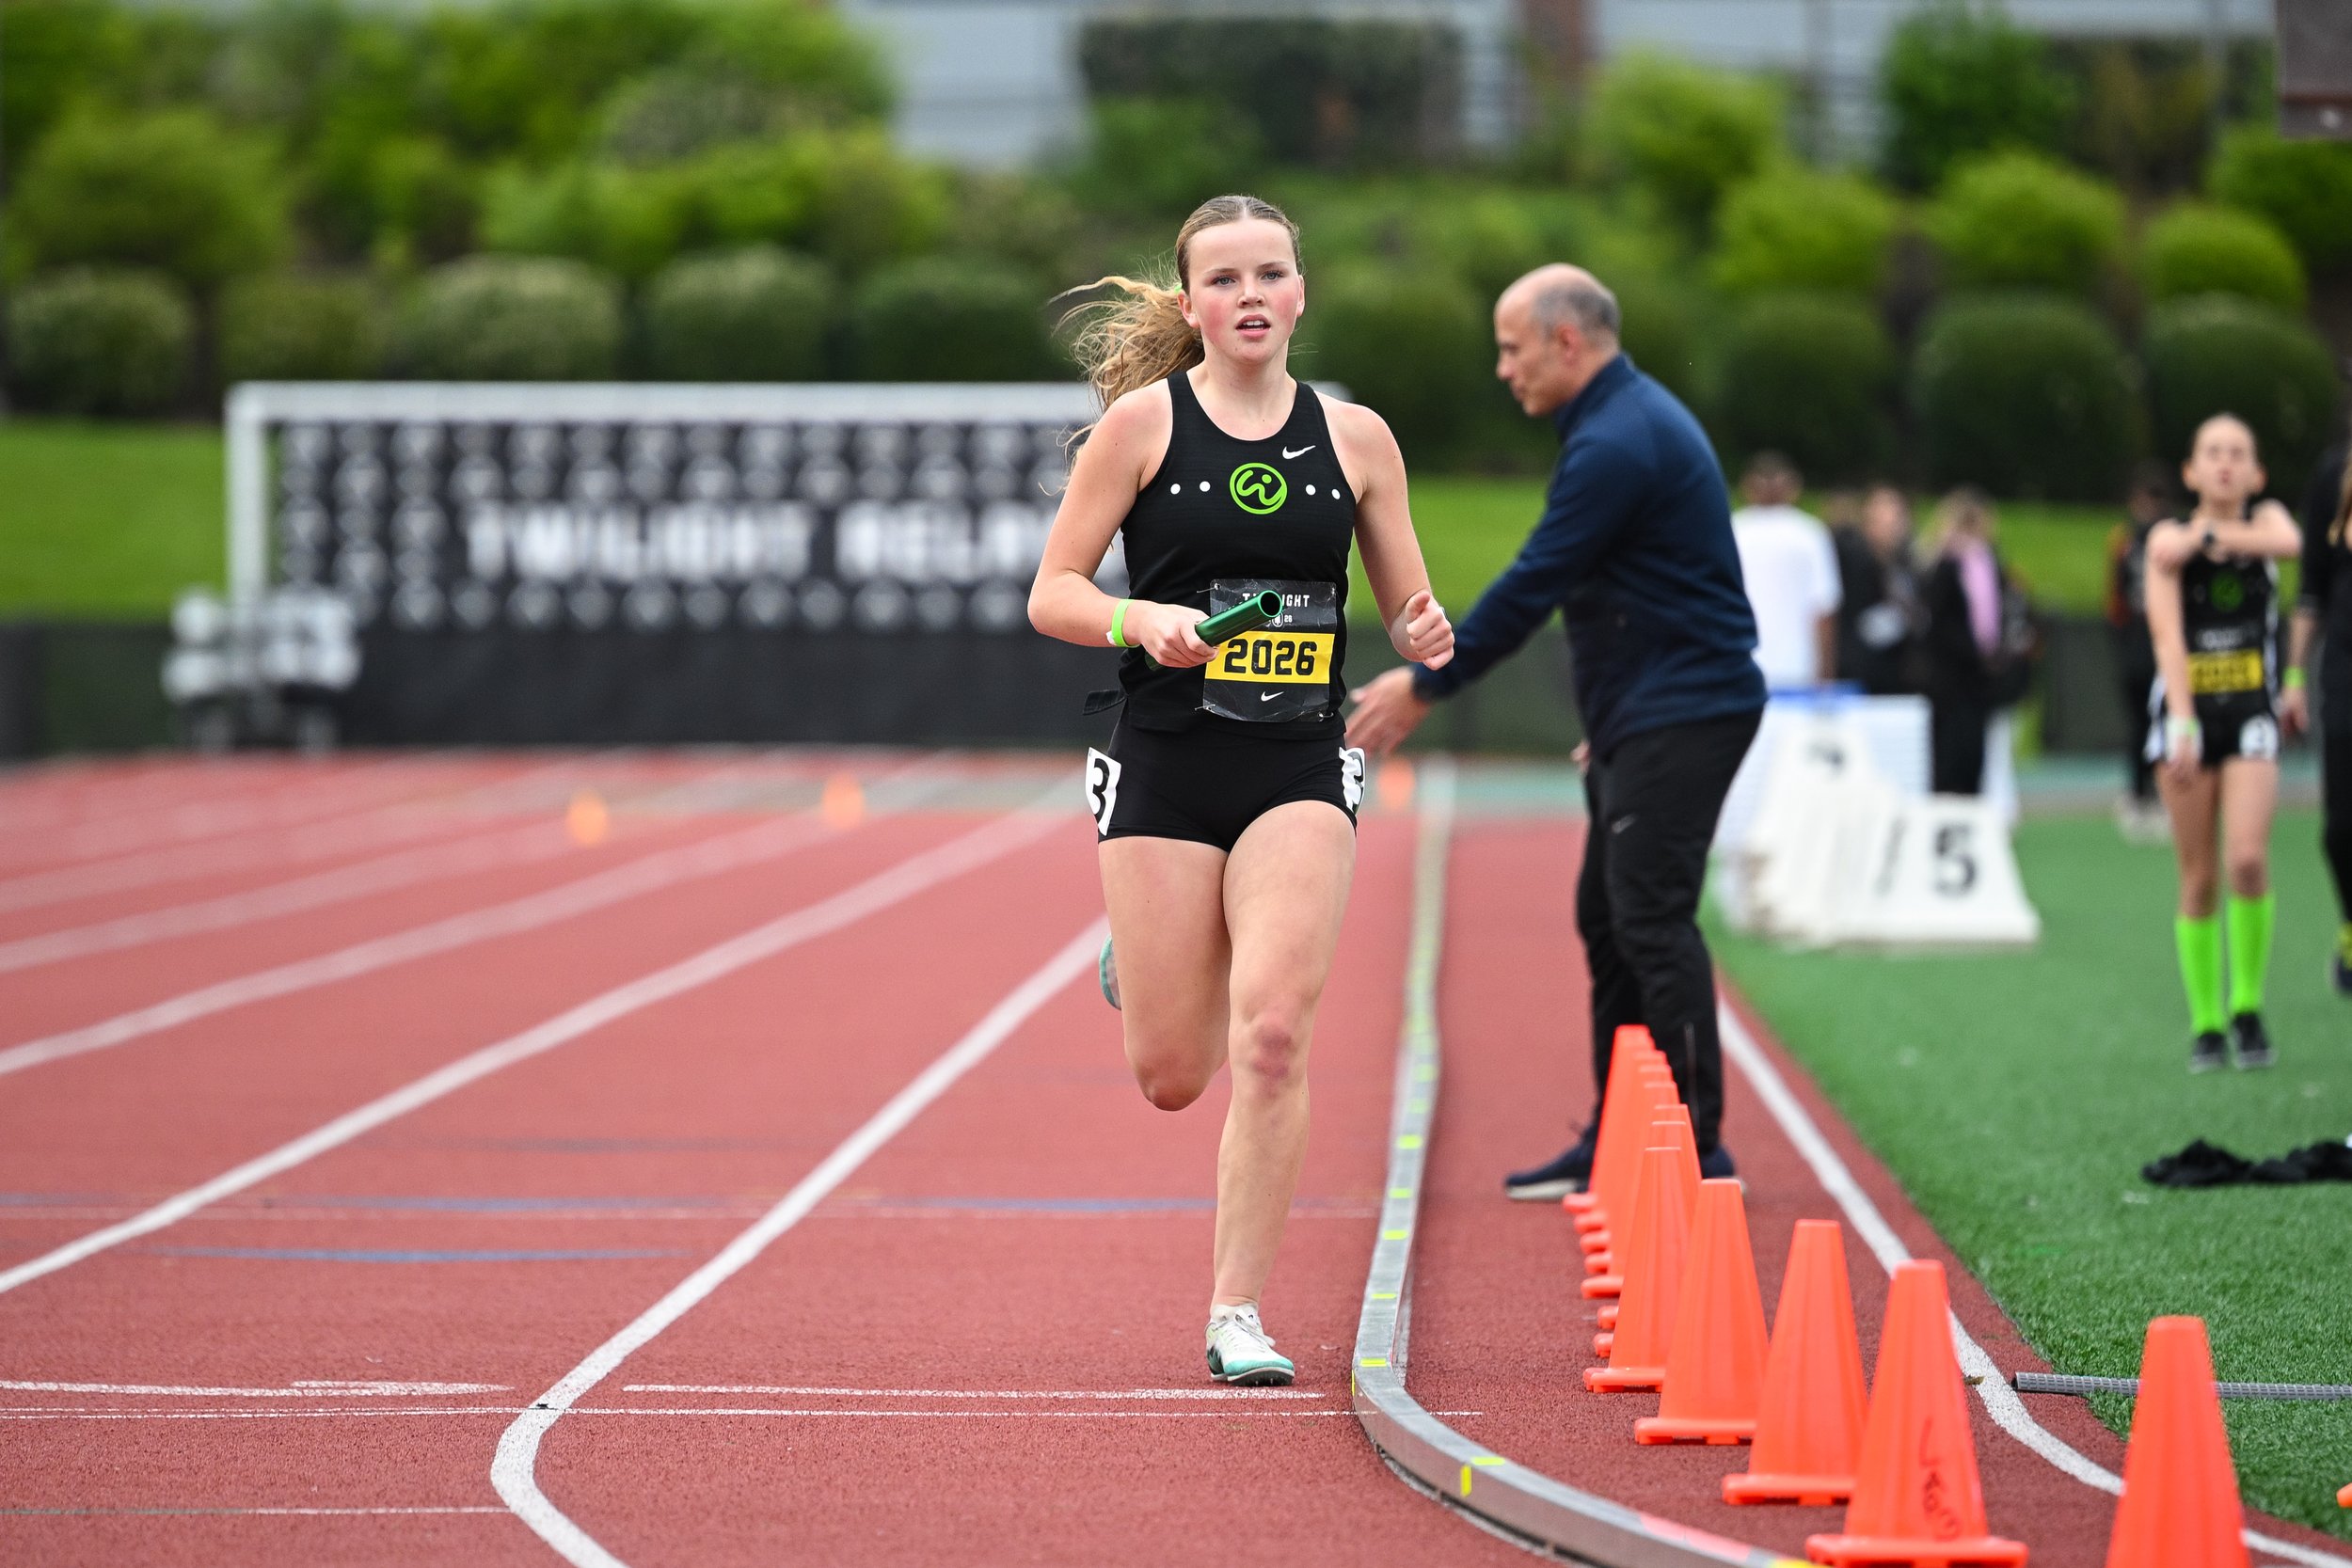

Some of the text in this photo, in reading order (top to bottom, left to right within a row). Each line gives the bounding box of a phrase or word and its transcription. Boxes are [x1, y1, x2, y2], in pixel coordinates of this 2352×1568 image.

[1242, 593, 1310, 608] TIGHT
[1224, 639, 1317, 675] 2026
[1092, 757, 1110, 825] 3
[1934, 821, 1977, 896] 5
